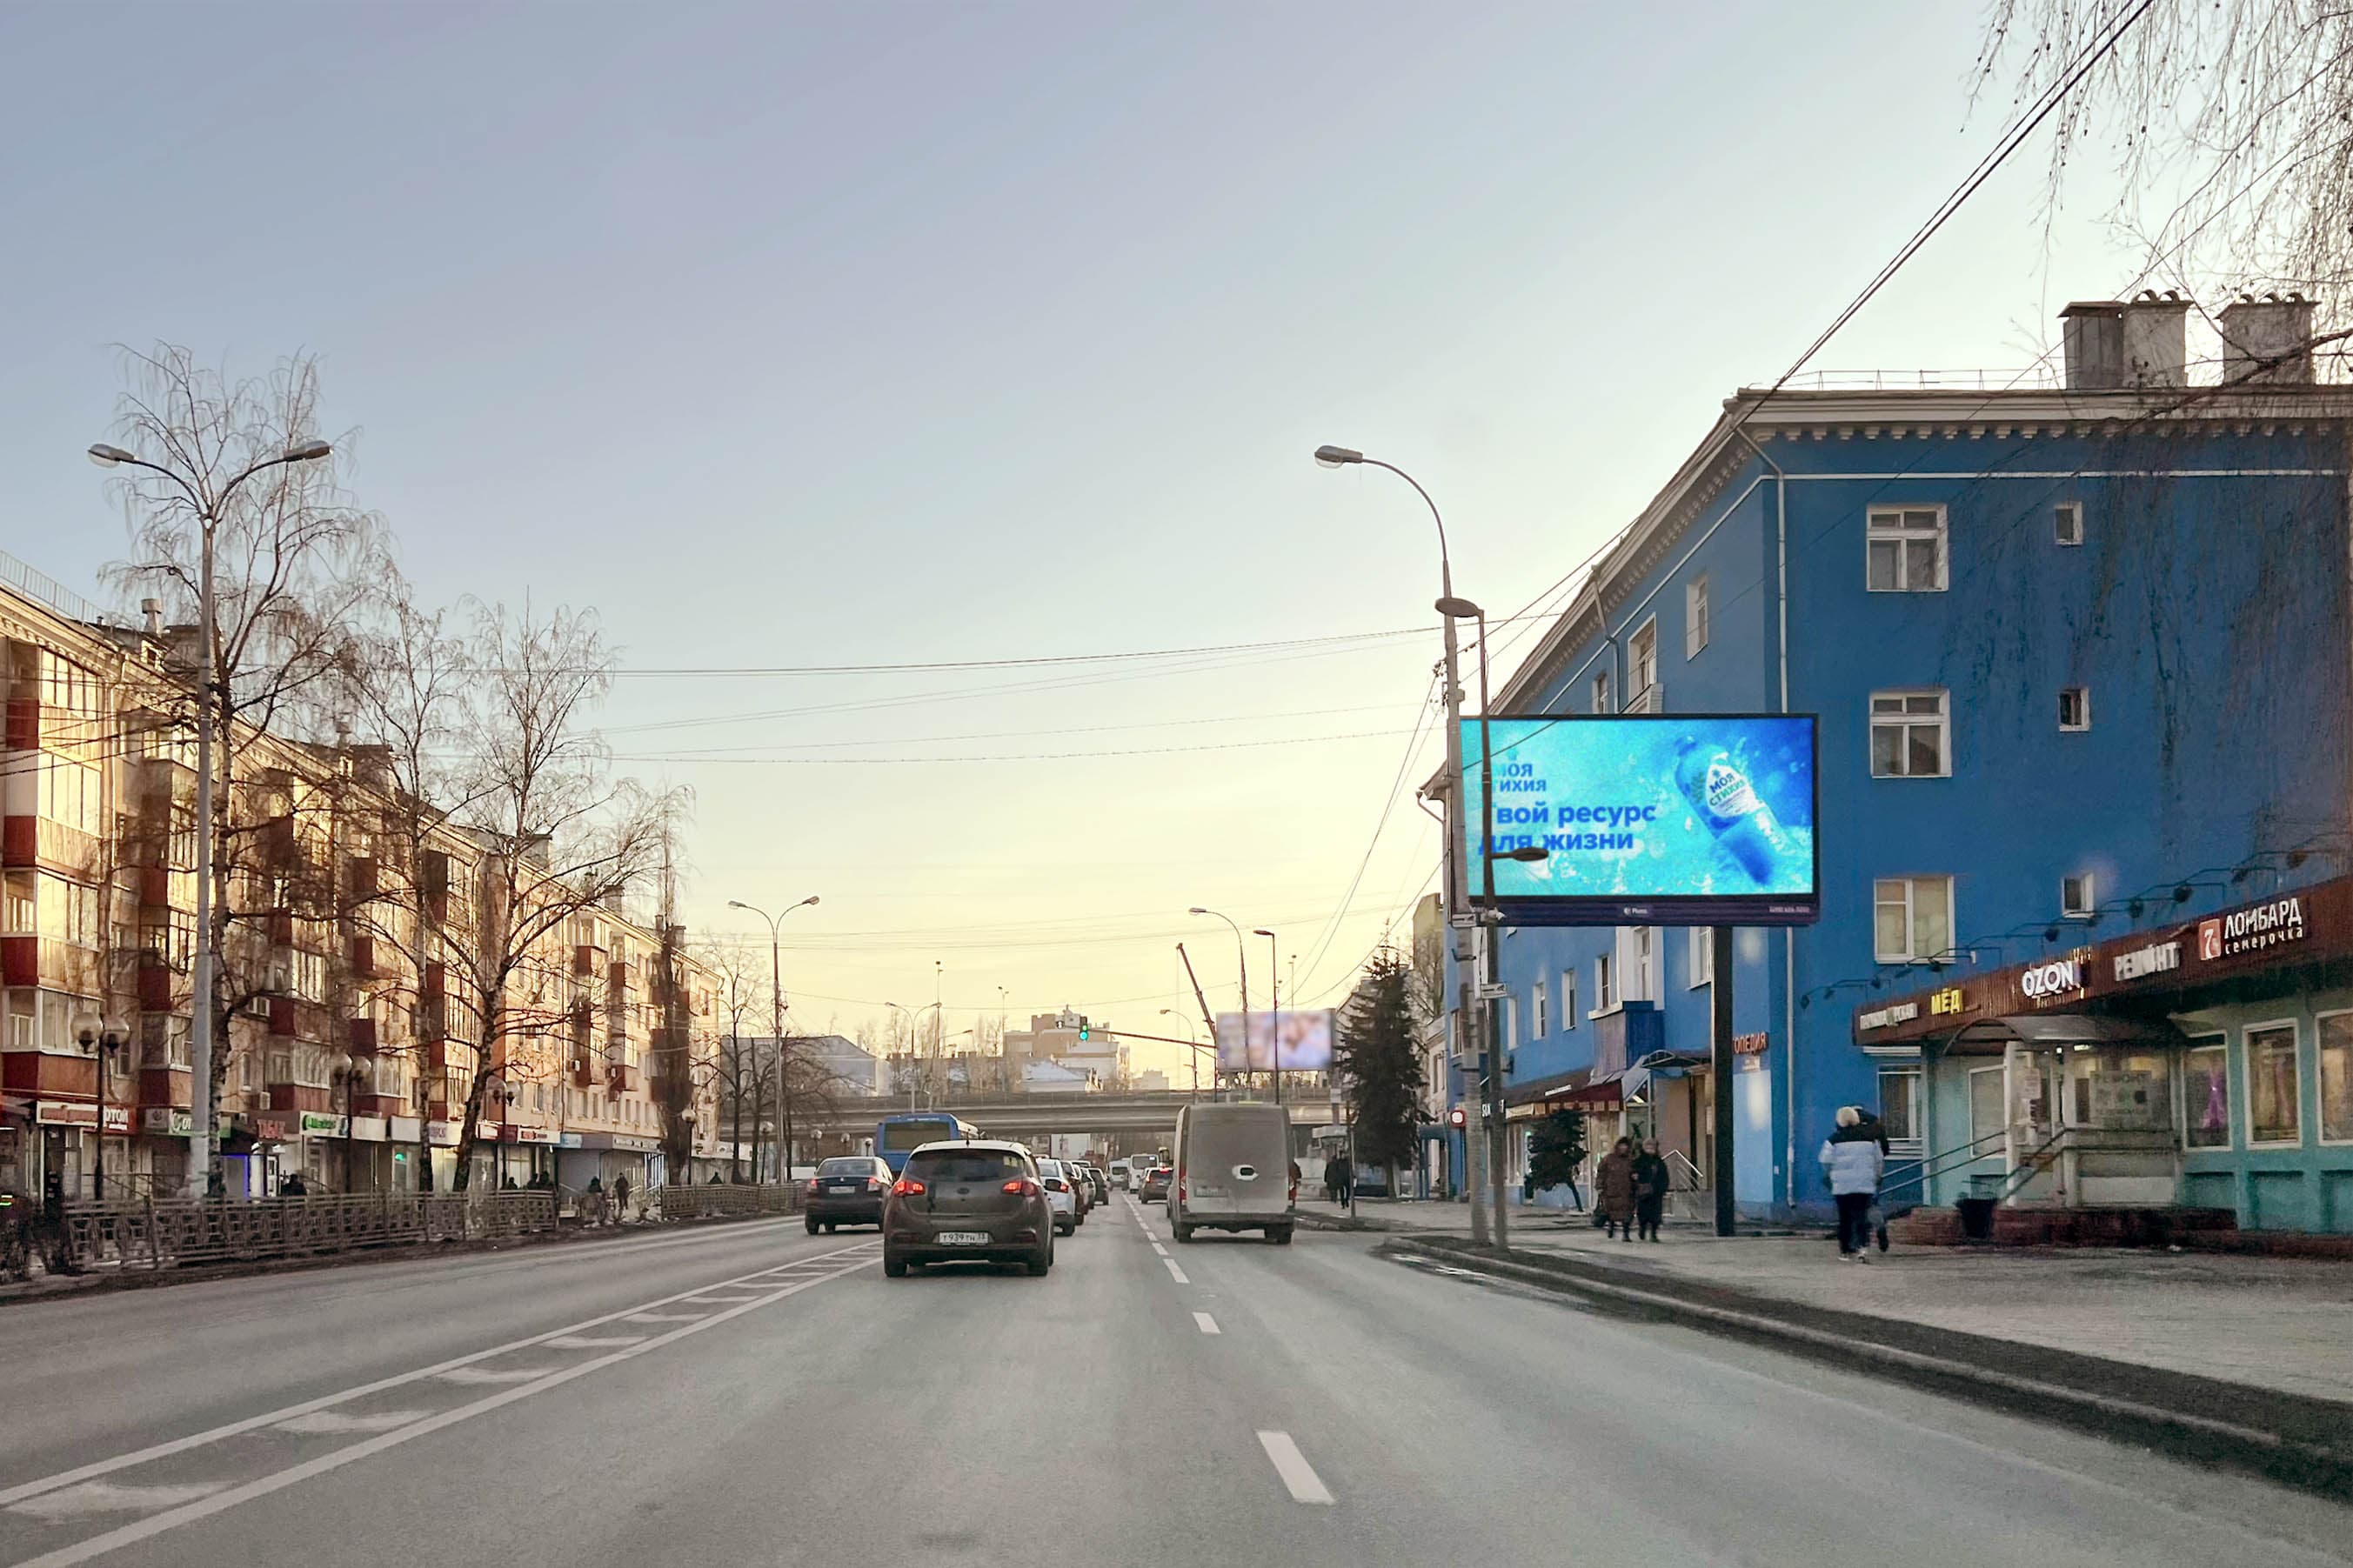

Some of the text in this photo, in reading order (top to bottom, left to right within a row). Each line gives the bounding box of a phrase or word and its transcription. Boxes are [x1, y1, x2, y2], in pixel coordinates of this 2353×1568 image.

[1480, 801, 1656, 828] вой ресурс
[1542, 833, 1634, 851] жизни
[2224, 897, 2303, 939] ЛОМБАРД
[2022, 960, 2075, 997] OZON
[1931, 988, 1963, 1015] МЁД
[1733, 1031, 1767, 1054] ОПЕДИЯ
